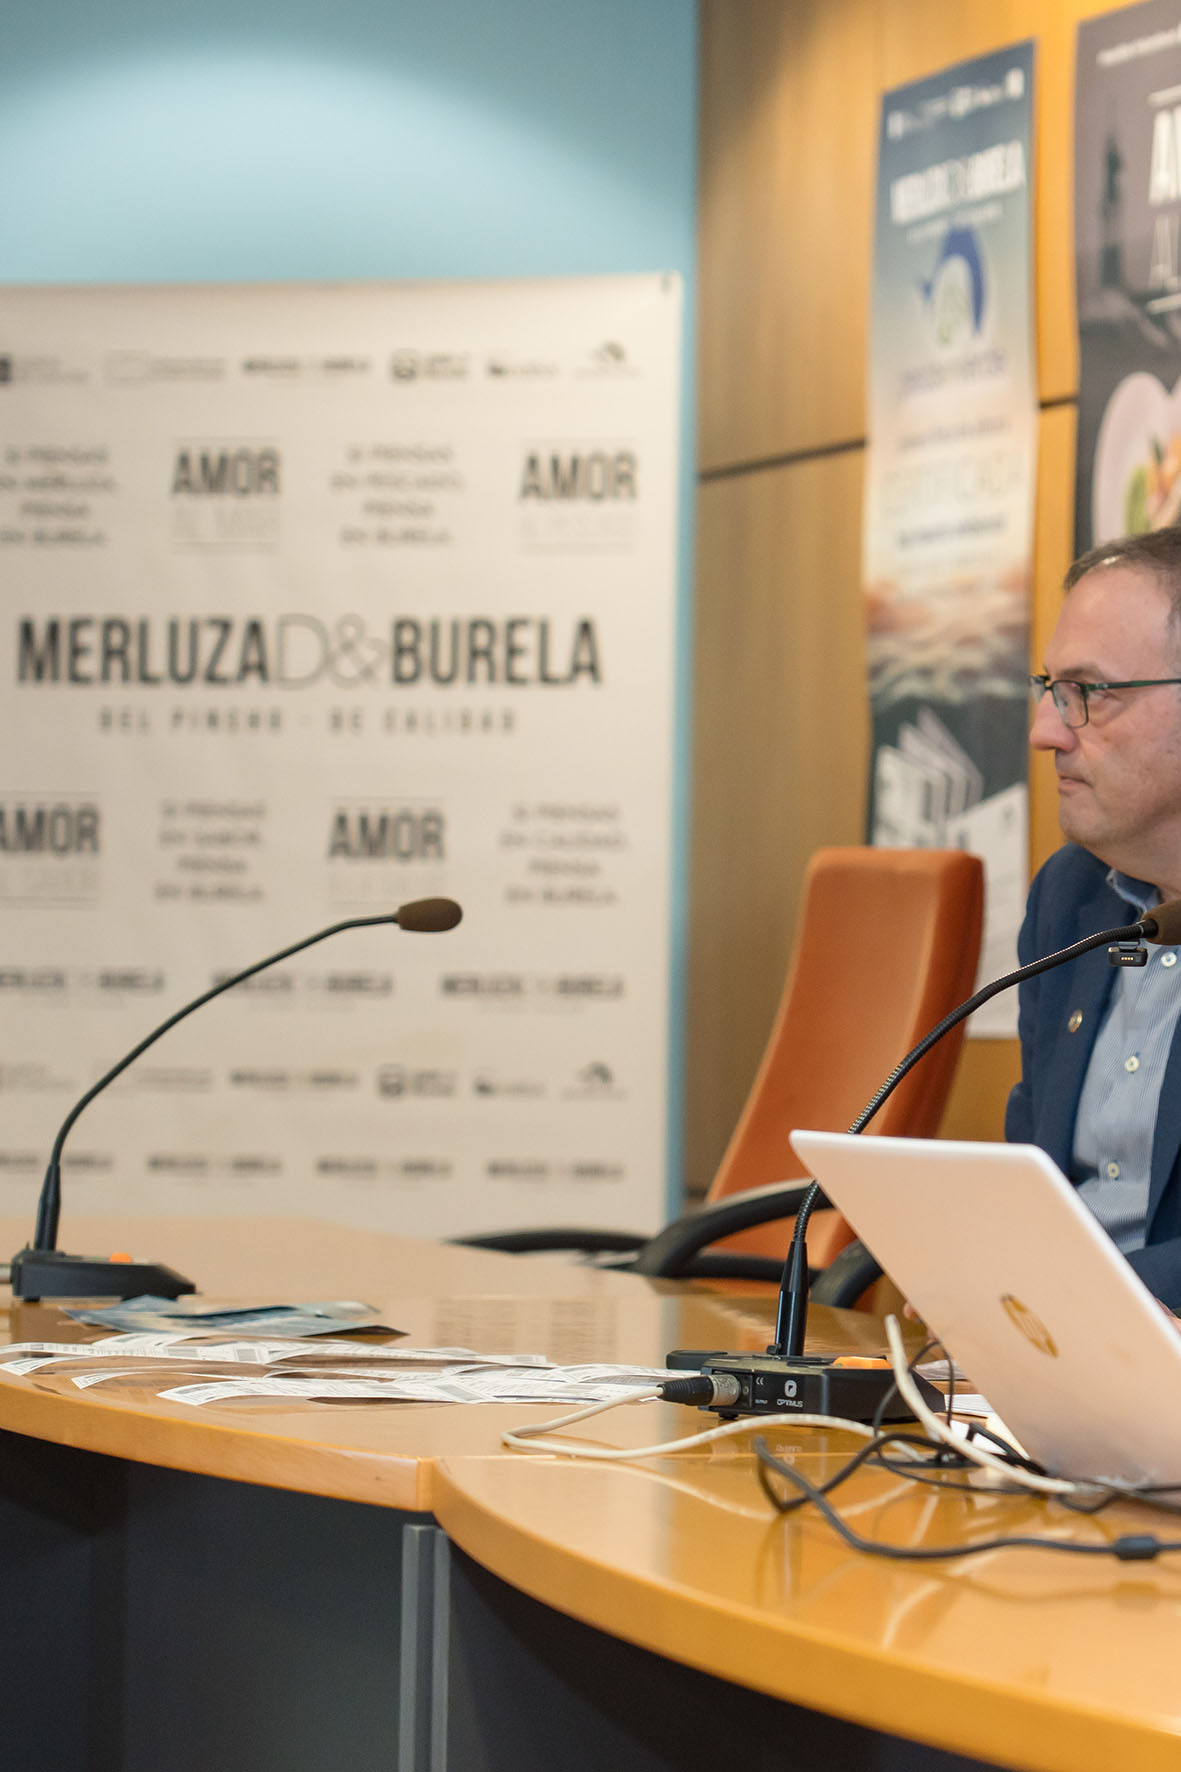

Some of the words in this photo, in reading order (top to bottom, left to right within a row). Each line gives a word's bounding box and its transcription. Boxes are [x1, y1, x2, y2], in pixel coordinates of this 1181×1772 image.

[172, 446, 281, 497] AMOR
[520, 448, 638, 502] AMOR
[327, 807, 446, 864] AMOR
